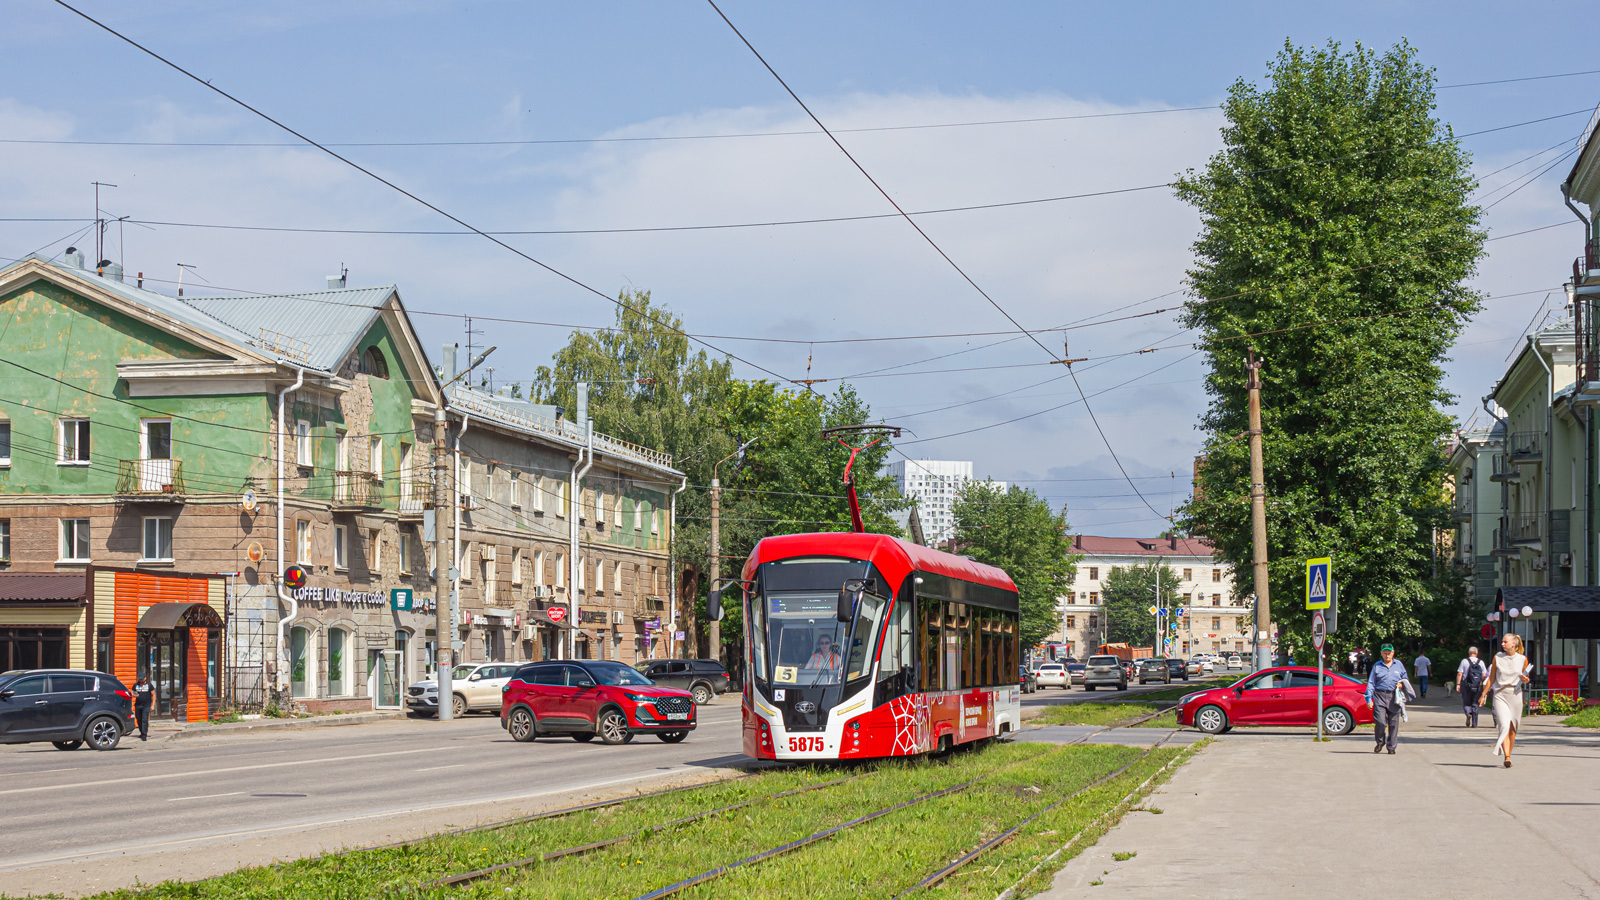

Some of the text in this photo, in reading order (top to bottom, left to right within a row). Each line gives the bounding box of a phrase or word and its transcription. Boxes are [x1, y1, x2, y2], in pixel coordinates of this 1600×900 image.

[293, 586, 340, 602] COFFEE LIKE
[342, 588, 361, 605] кофе
[368, 590, 387, 605] собой
[782, 669, 792, 681] 5
[788, 736, 825, 752] 5875
